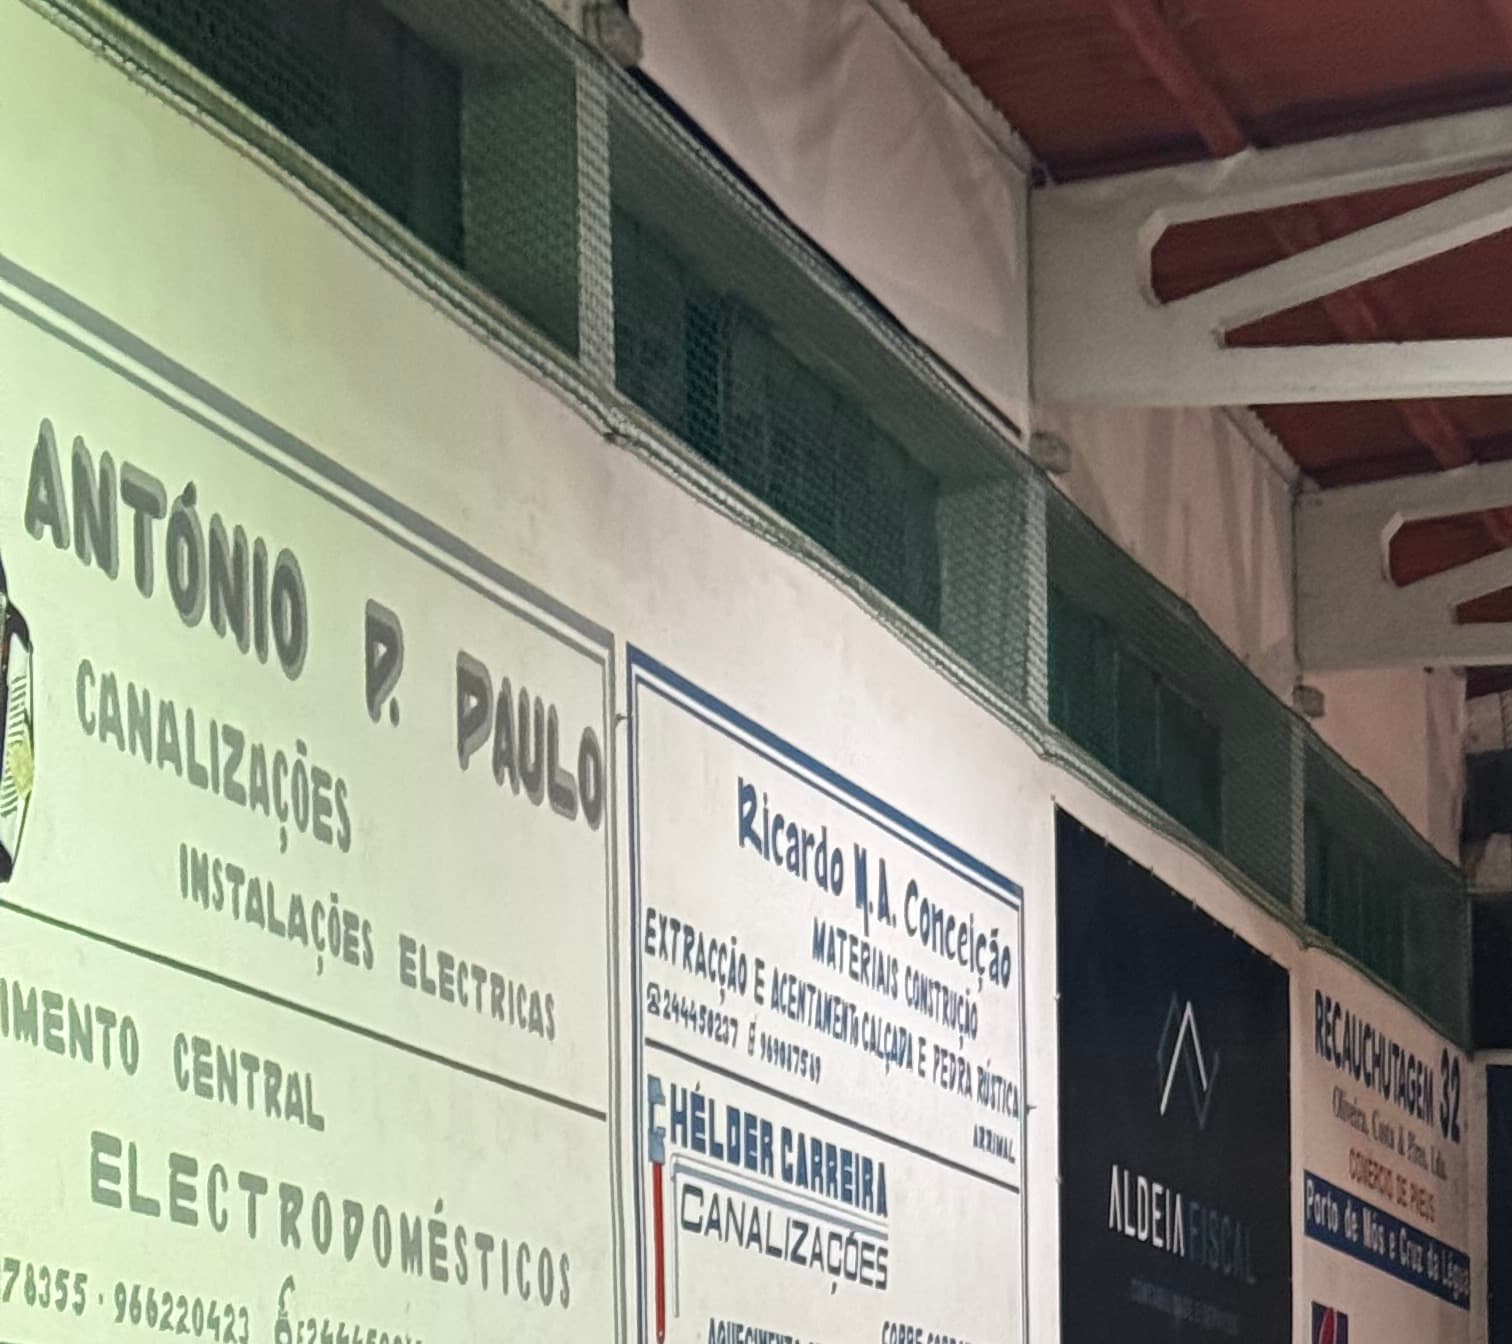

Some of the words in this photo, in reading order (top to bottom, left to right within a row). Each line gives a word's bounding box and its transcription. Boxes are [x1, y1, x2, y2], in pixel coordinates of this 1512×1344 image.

[25, 417, 309, 681] ANTÓNIO
[365, 599, 404, 727] P.
[457, 649, 603, 832] PAULO
[76, 659, 352, 853] CANALIZAÇÕES
[179, 842, 374, 976] INSTALAÇÕES
[400, 933, 556, 1042] ELECTRICAS
[738, 776, 844, 896] Ricardo
[904, 879, 1012, 992] Conceição
[645, 907, 747, 1004] EXTRACÇÃO
[754, 958, 765, 1006] E
[862, 1011, 913, 1076] CALÇADA
[918, 1037, 926, 1078] E
[933, 1044, 973, 1097] PEDRA
[976, 1058, 1020, 1120] RÚSTICA
[812, 916, 898, 1001] MATERIAIS
[904, 965, 978, 1050] CONSTRUÇÃO
[1314, 988, 1434, 1129] RECAUCHUTAGEM
[1438, 1048, 1462, 1145] 32
[173, 1032, 326, 1133] CENTRAL
[669, 1081, 775, 1178] HÉLDER
[780, 1126, 889, 1218] CARREIRA
[90, 1129, 571, 1309] ELECTRODOMÉSTICOS
[1108, 1164, 1185, 1258] ALDEIA
[1306, 1180, 1339, 1234] Porto
[1344, 1193, 1360, 1243] de
